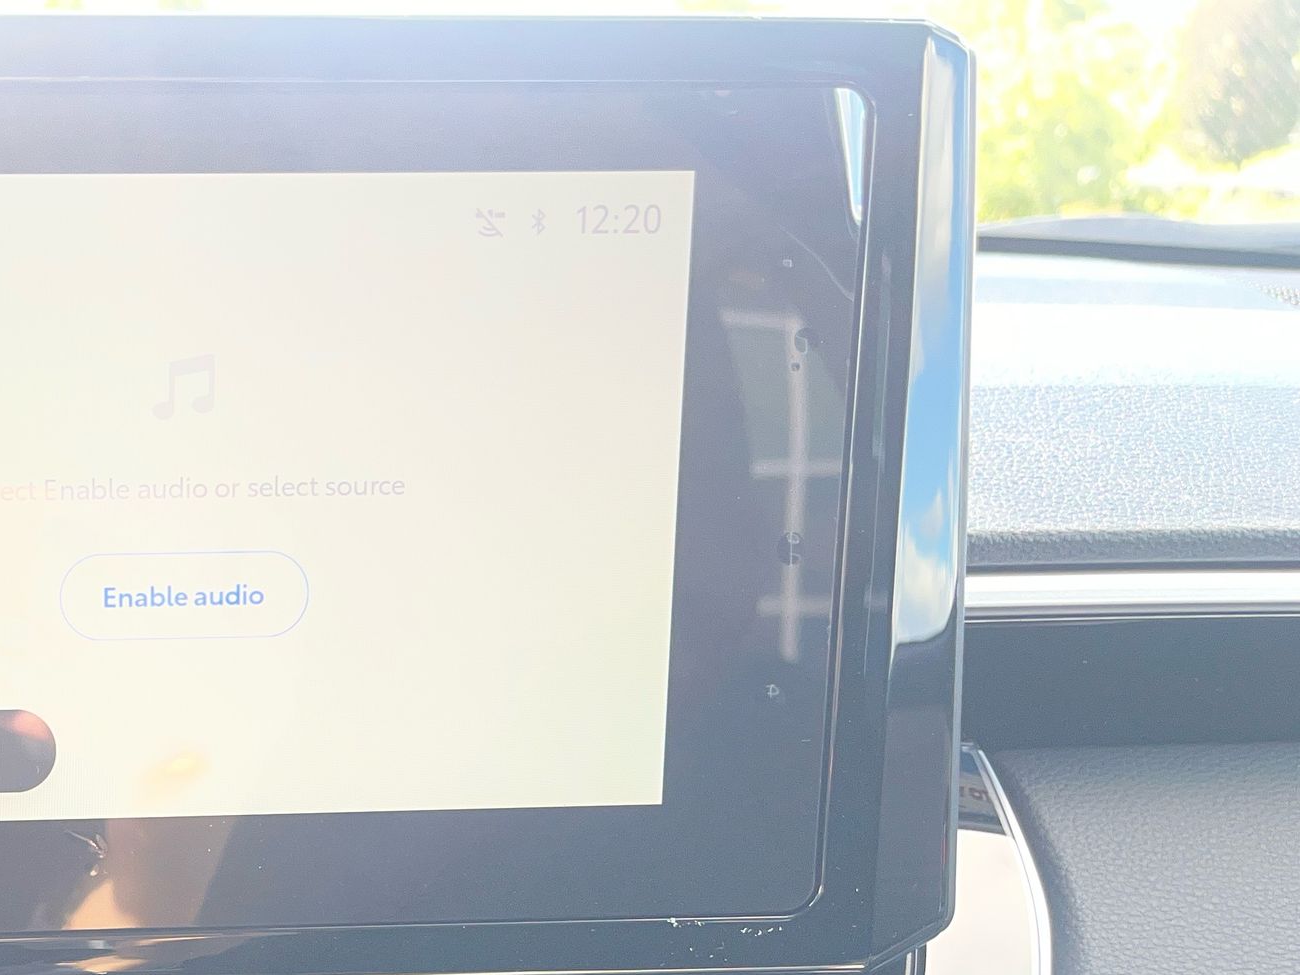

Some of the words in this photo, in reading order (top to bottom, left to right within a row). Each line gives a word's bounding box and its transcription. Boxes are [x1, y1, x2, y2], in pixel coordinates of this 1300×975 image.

[577, 204, 662, 235] 12:20
[44, 478, 130, 500] Enable
[138, 477, 209, 500] audio
[215, 483, 237, 498] or
[247, 477, 319, 498] select
[325, 480, 406, 496] source
[103, 586, 189, 608] Enable
[193, 583, 265, 607] audio
